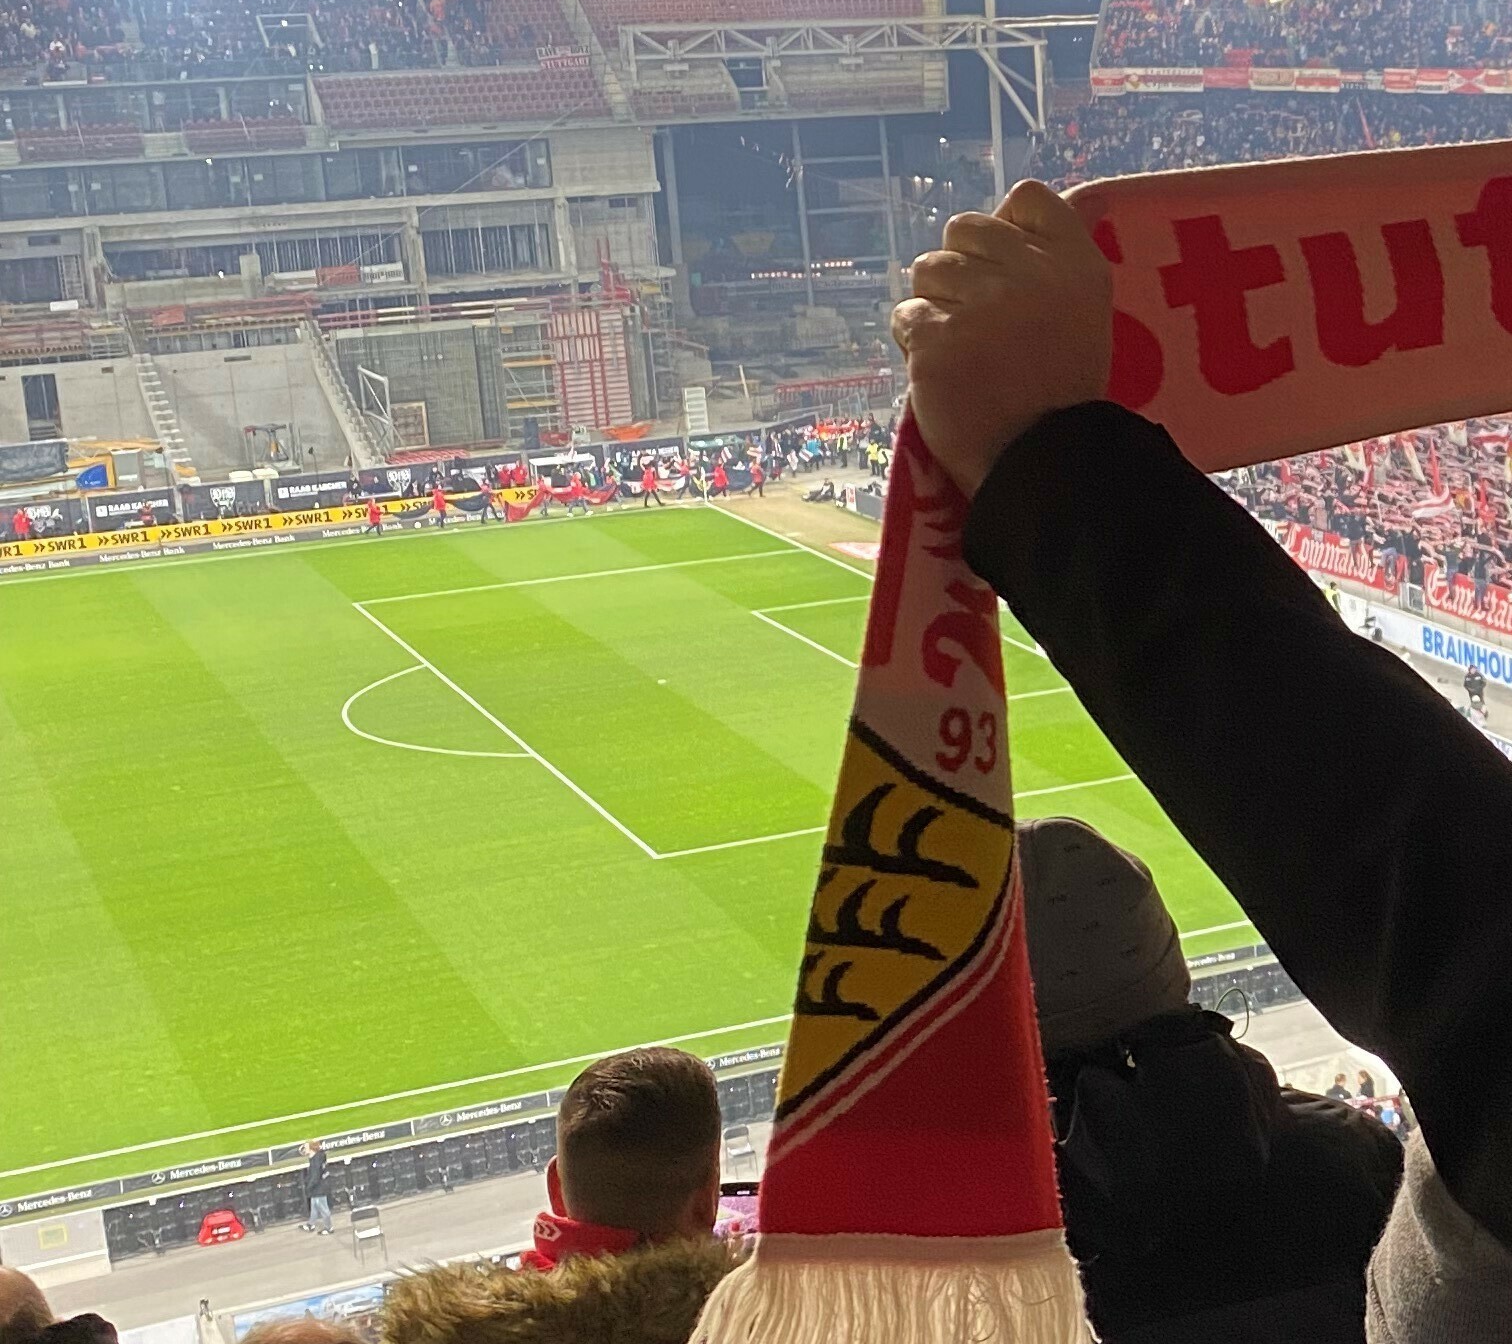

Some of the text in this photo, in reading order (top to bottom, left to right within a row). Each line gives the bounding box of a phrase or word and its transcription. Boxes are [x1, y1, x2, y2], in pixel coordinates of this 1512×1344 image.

[234, 517, 273, 531] SWR1
[295, 511, 333, 525] SWR1
[111, 530, 150, 545] SWR1
[174, 523, 212, 538] SWR1
[48, 537, 87, 552] SWR1
[212, 534, 295, 550] Mercedes-Benz Bank
[100, 546, 185, 563] Mercedes-Benz Bank
[0, 559, 70, 575] cedes-Benz Bank
[936, 707, 996, 774] 93
[719, 1047, 780, 1068] Mercedes-Benz
[456, 1101, 522, 1122] Mercedes-Benz
[170, 1158, 242, 1180] Mercedes-Benz
[17, 1189, 92, 1212] Mercedes-Benz
